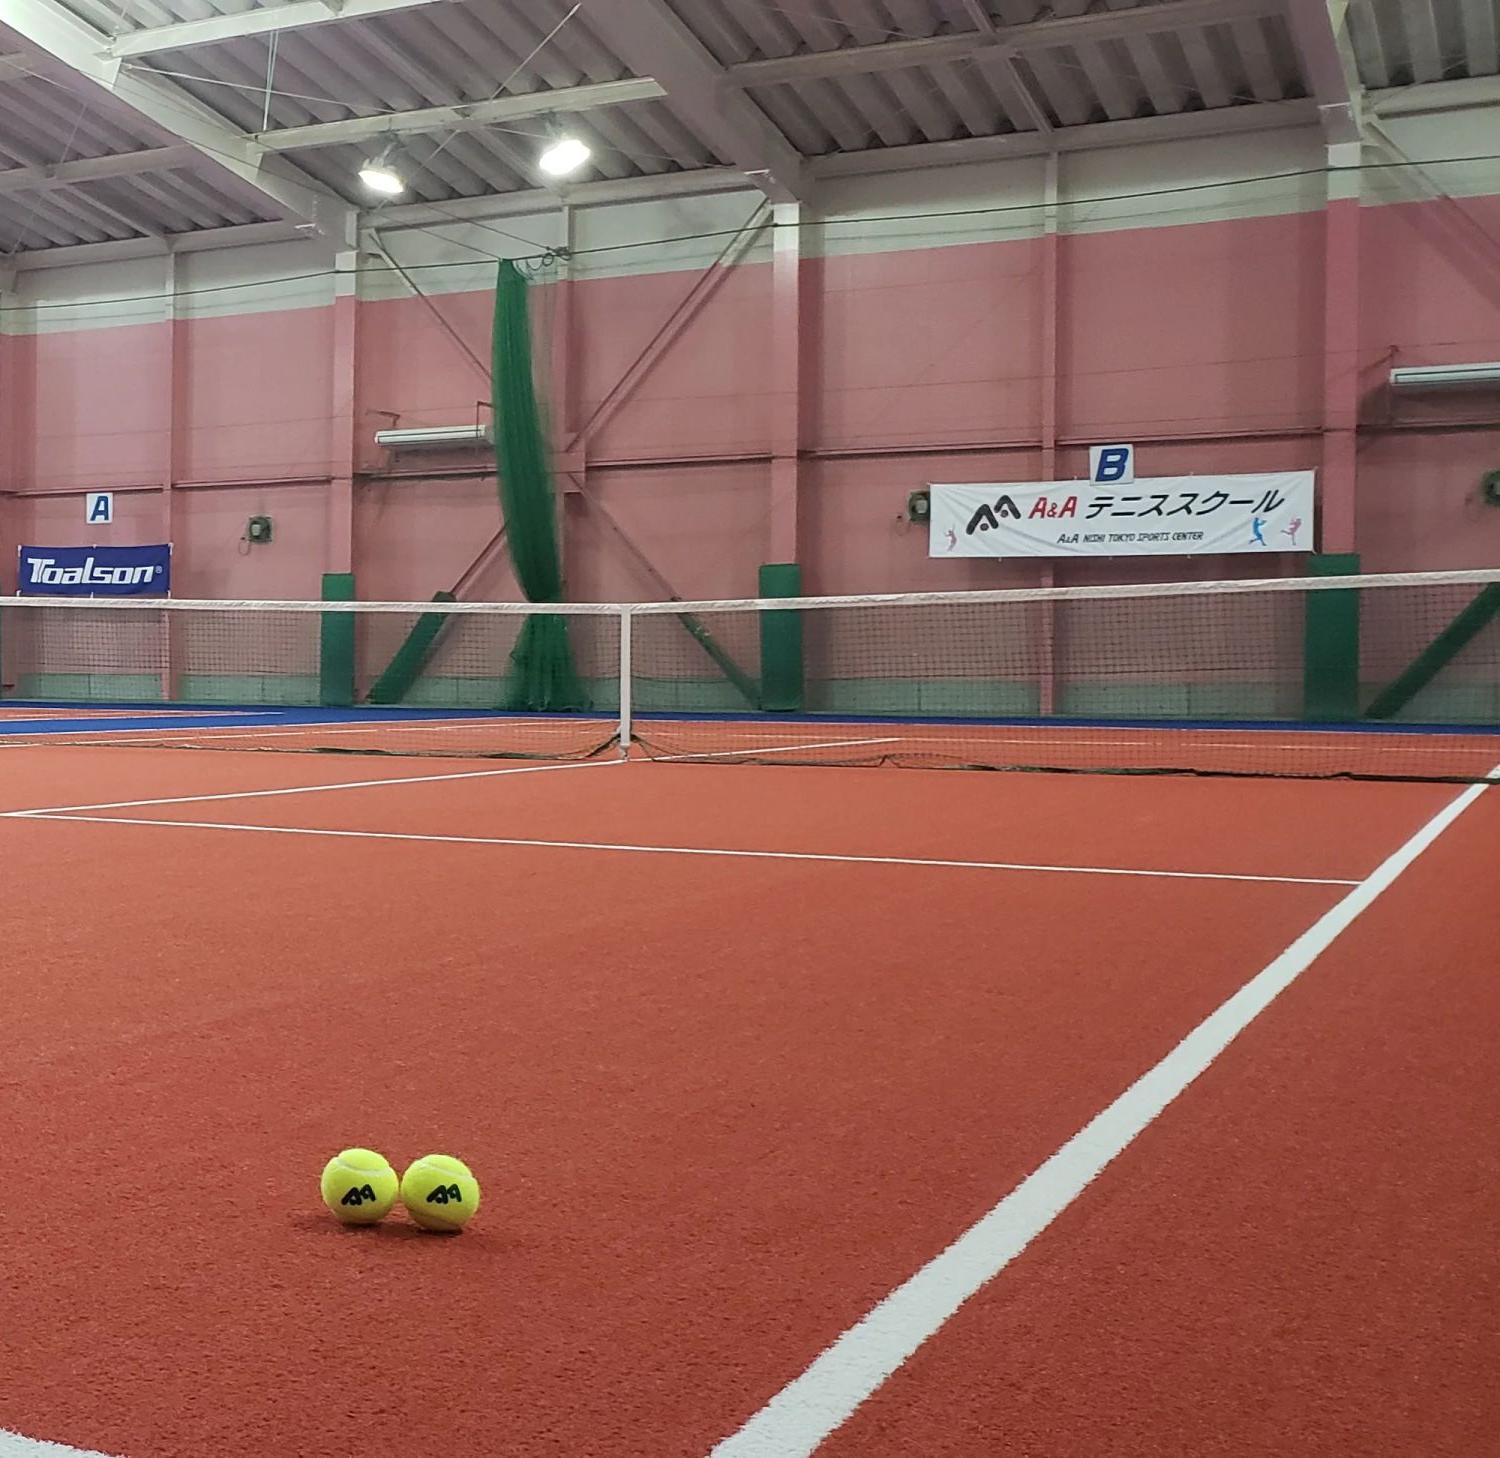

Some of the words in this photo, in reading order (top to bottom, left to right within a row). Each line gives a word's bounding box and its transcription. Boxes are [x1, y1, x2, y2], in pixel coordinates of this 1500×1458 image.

[1095, 448, 1129, 482] B
[90, 495, 109, 521] A
[1028, 496, 1078, 519] A&A
[1085, 489, 1285, 519] テニススクール
[1082, 533, 1106, 543] NISHI
[1108, 532, 1136, 543] TOKYO
[1136, 531, 1171, 542] SPORTS
[1171, 531, 1204, 541] CENTER
